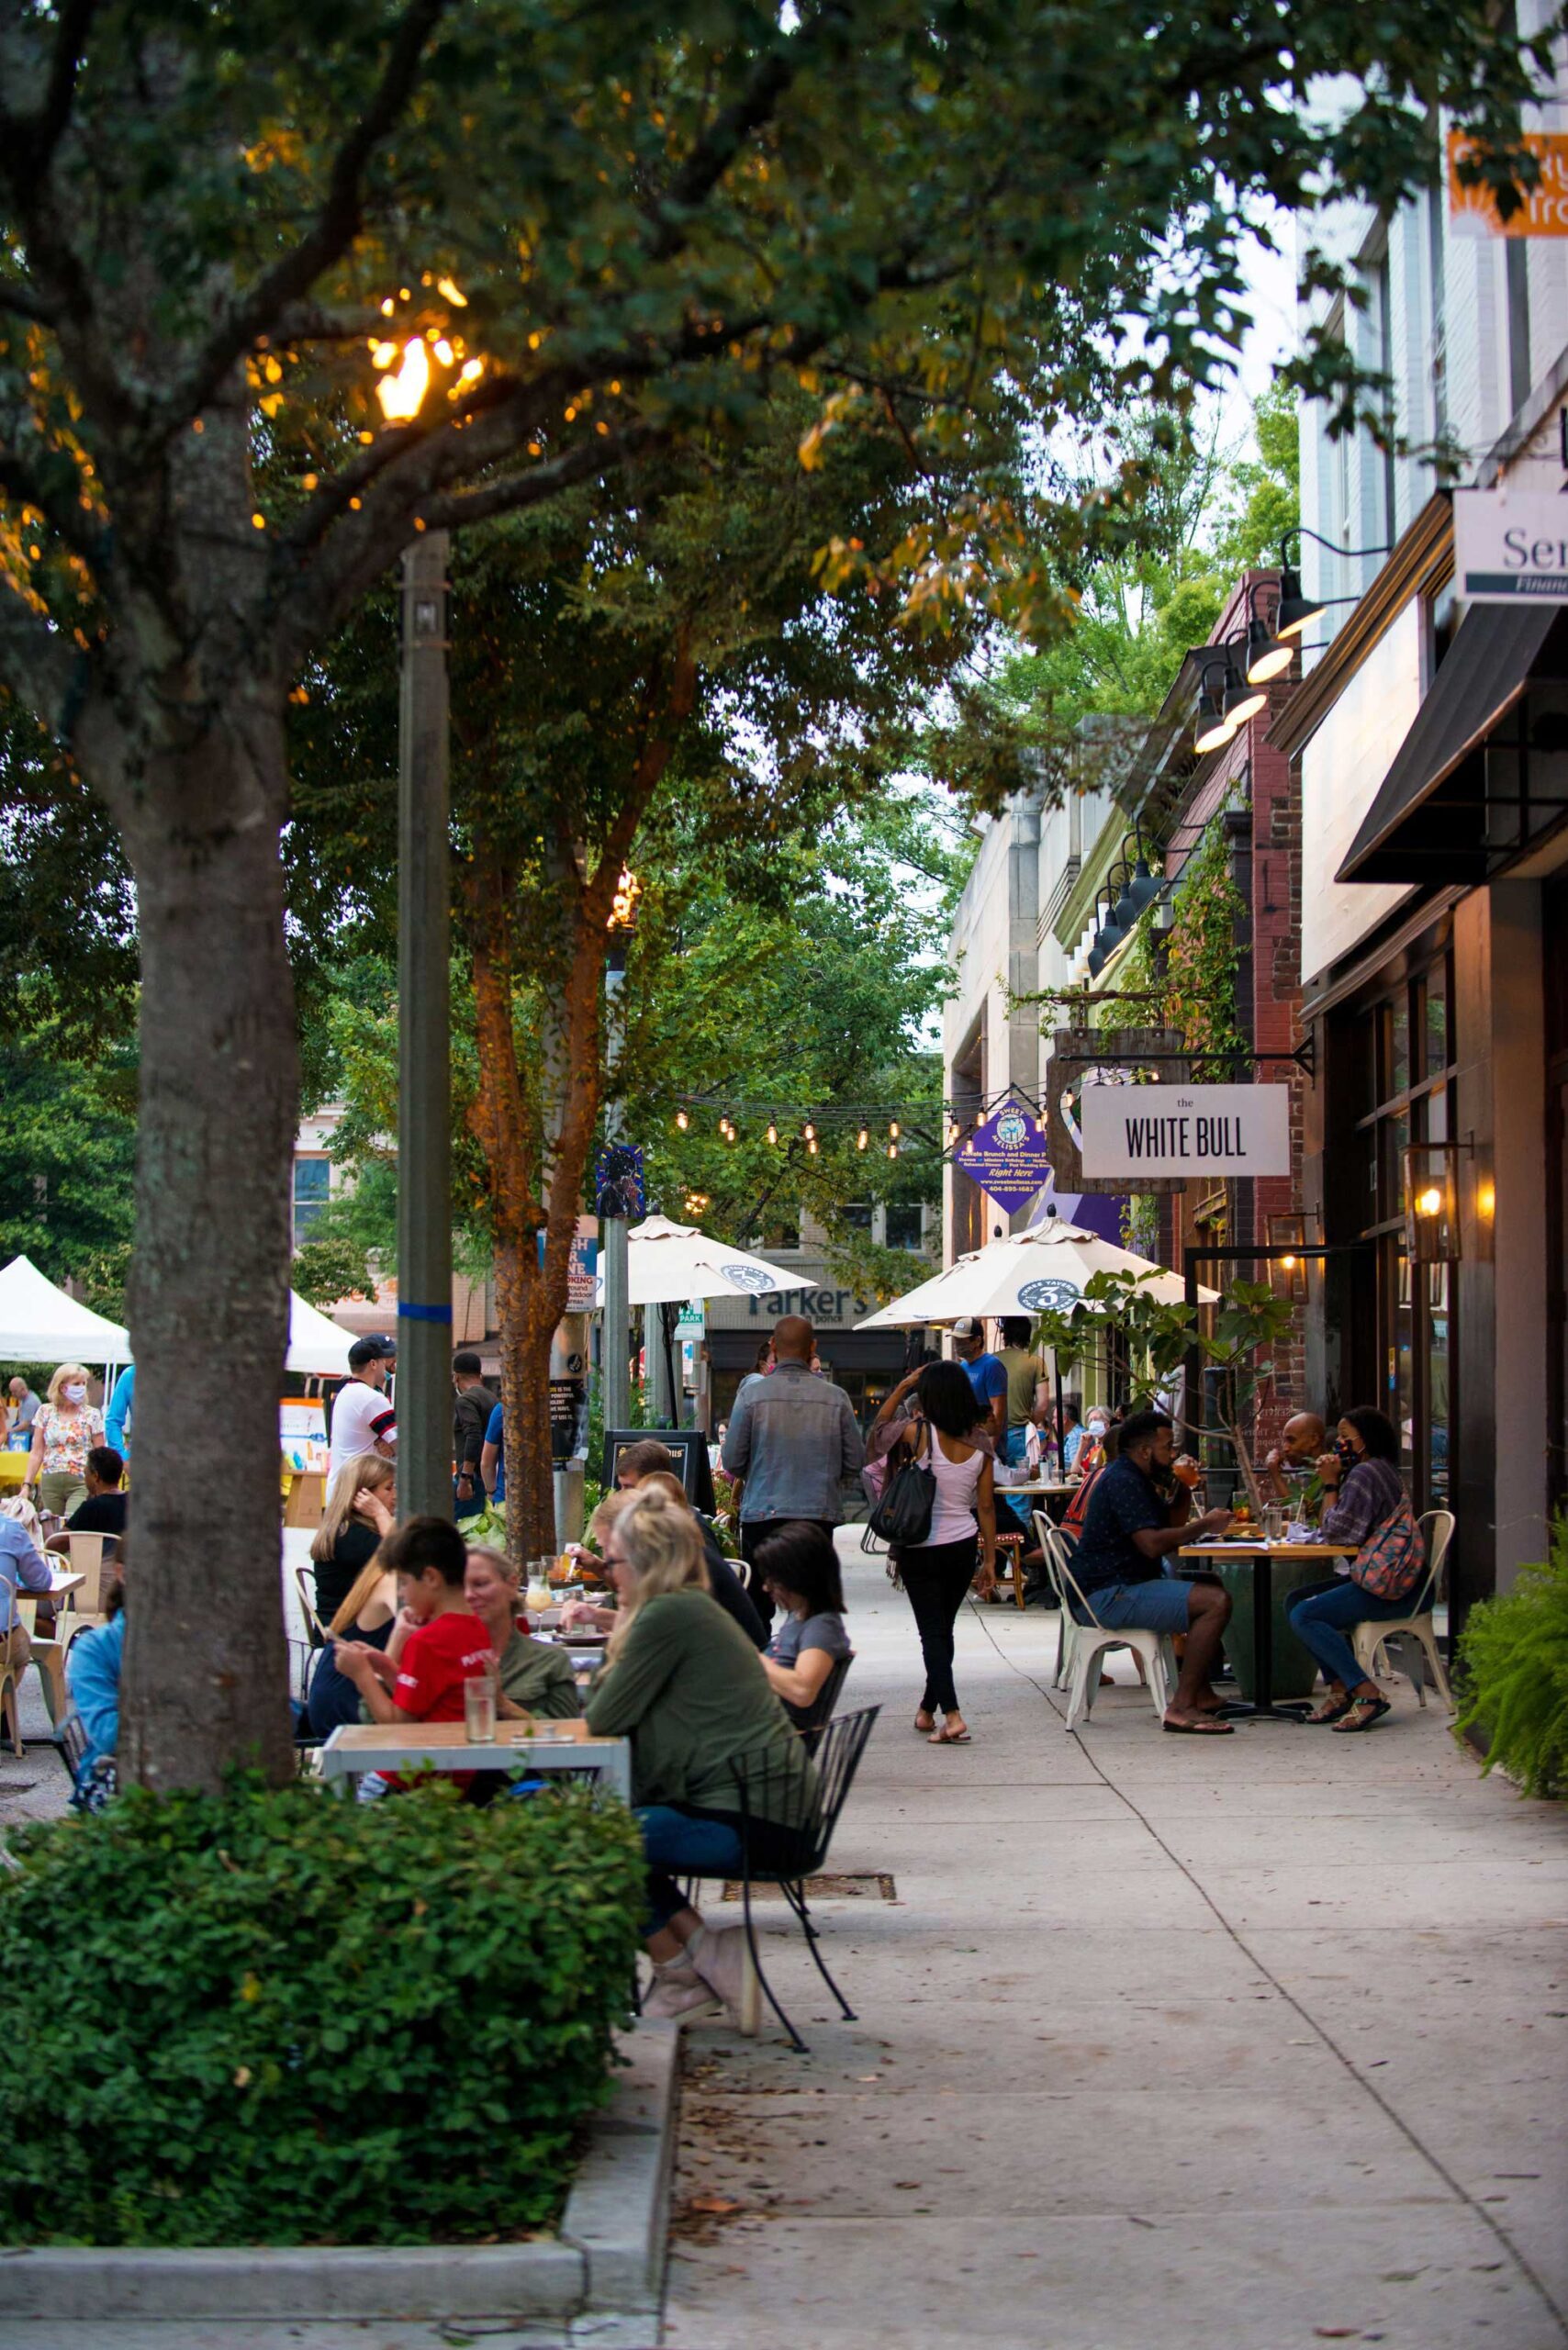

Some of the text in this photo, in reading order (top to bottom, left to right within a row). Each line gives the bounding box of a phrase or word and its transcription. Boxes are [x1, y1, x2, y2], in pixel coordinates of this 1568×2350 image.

[1177, 1098, 1193, 1107] the
[999, 1107, 1025, 1117] SWEET
[991, 1135, 1030, 1150] MELISSA'S
[1126, 1116, 1247, 1158] WHITE BULL
[989, 1169, 1034, 1178] Right Here
[1037, 1286, 1060, 1306] 3
